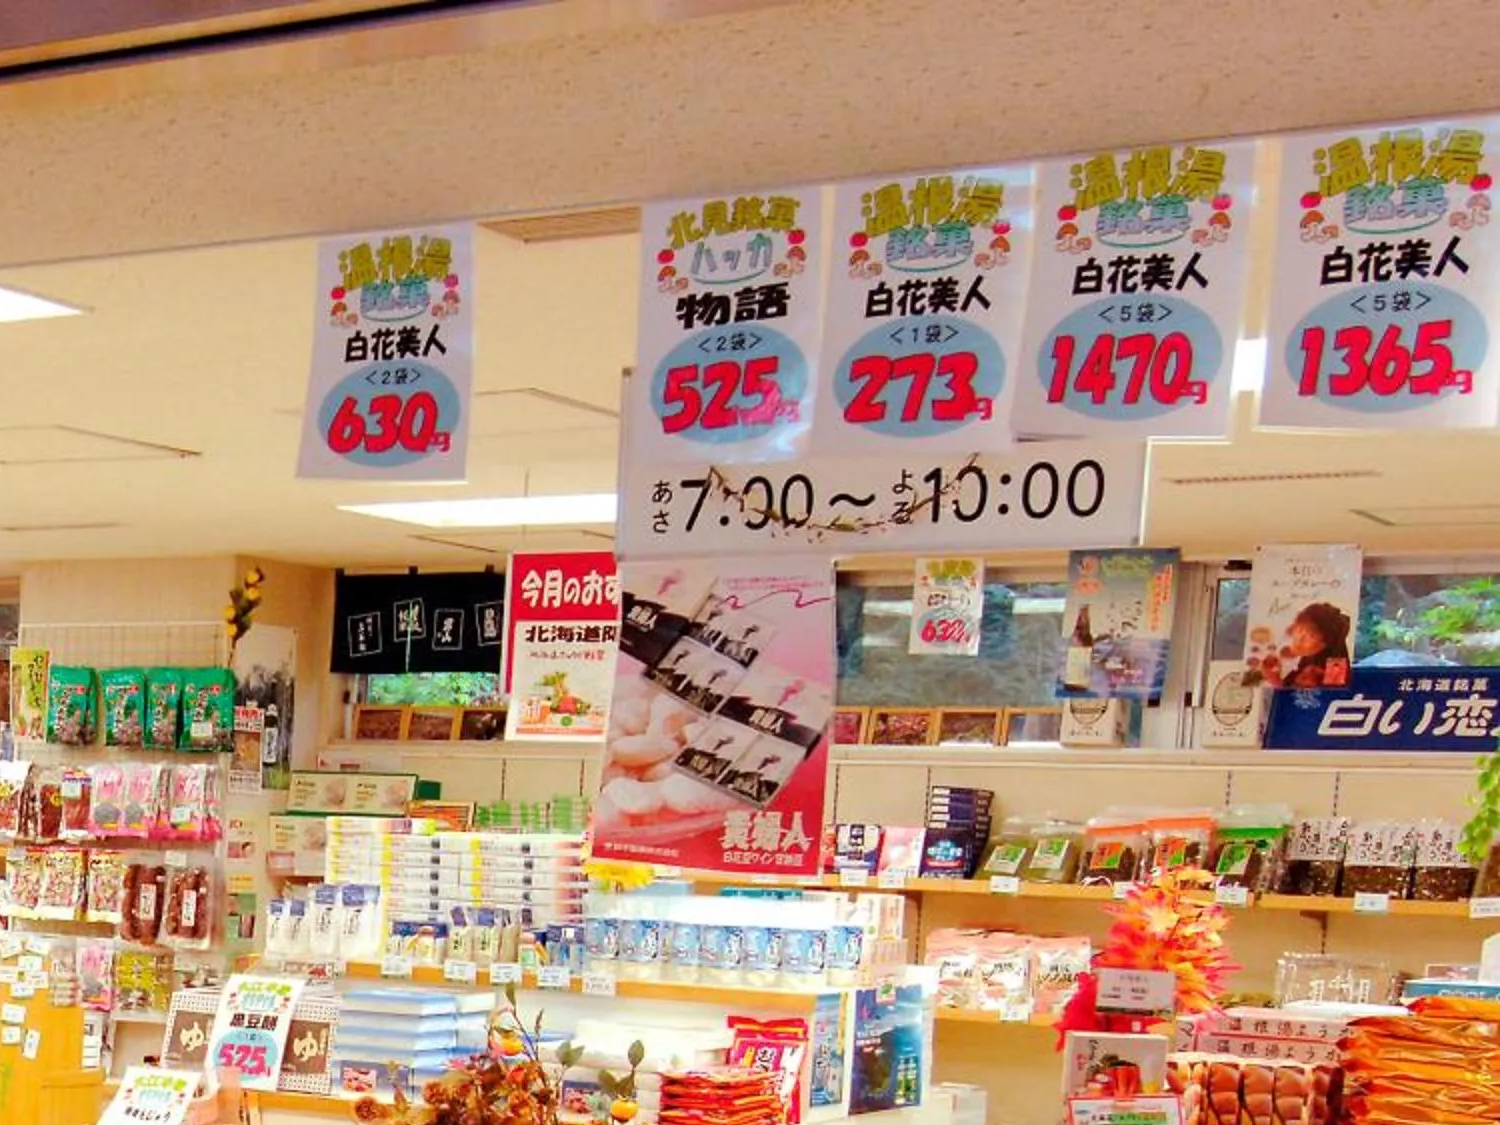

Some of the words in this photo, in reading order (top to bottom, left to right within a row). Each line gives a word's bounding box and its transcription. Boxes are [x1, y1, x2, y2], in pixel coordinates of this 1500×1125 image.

[688, 234, 775, 276] ハッカ
[1072, 251, 1210, 296] 白花美人
[1319, 236, 1471, 286] 白花美人
[675, 281, 792, 330] 物語
[865, 275, 992, 319] 白花美人
[345, 324, 448, 362] 白花美人
